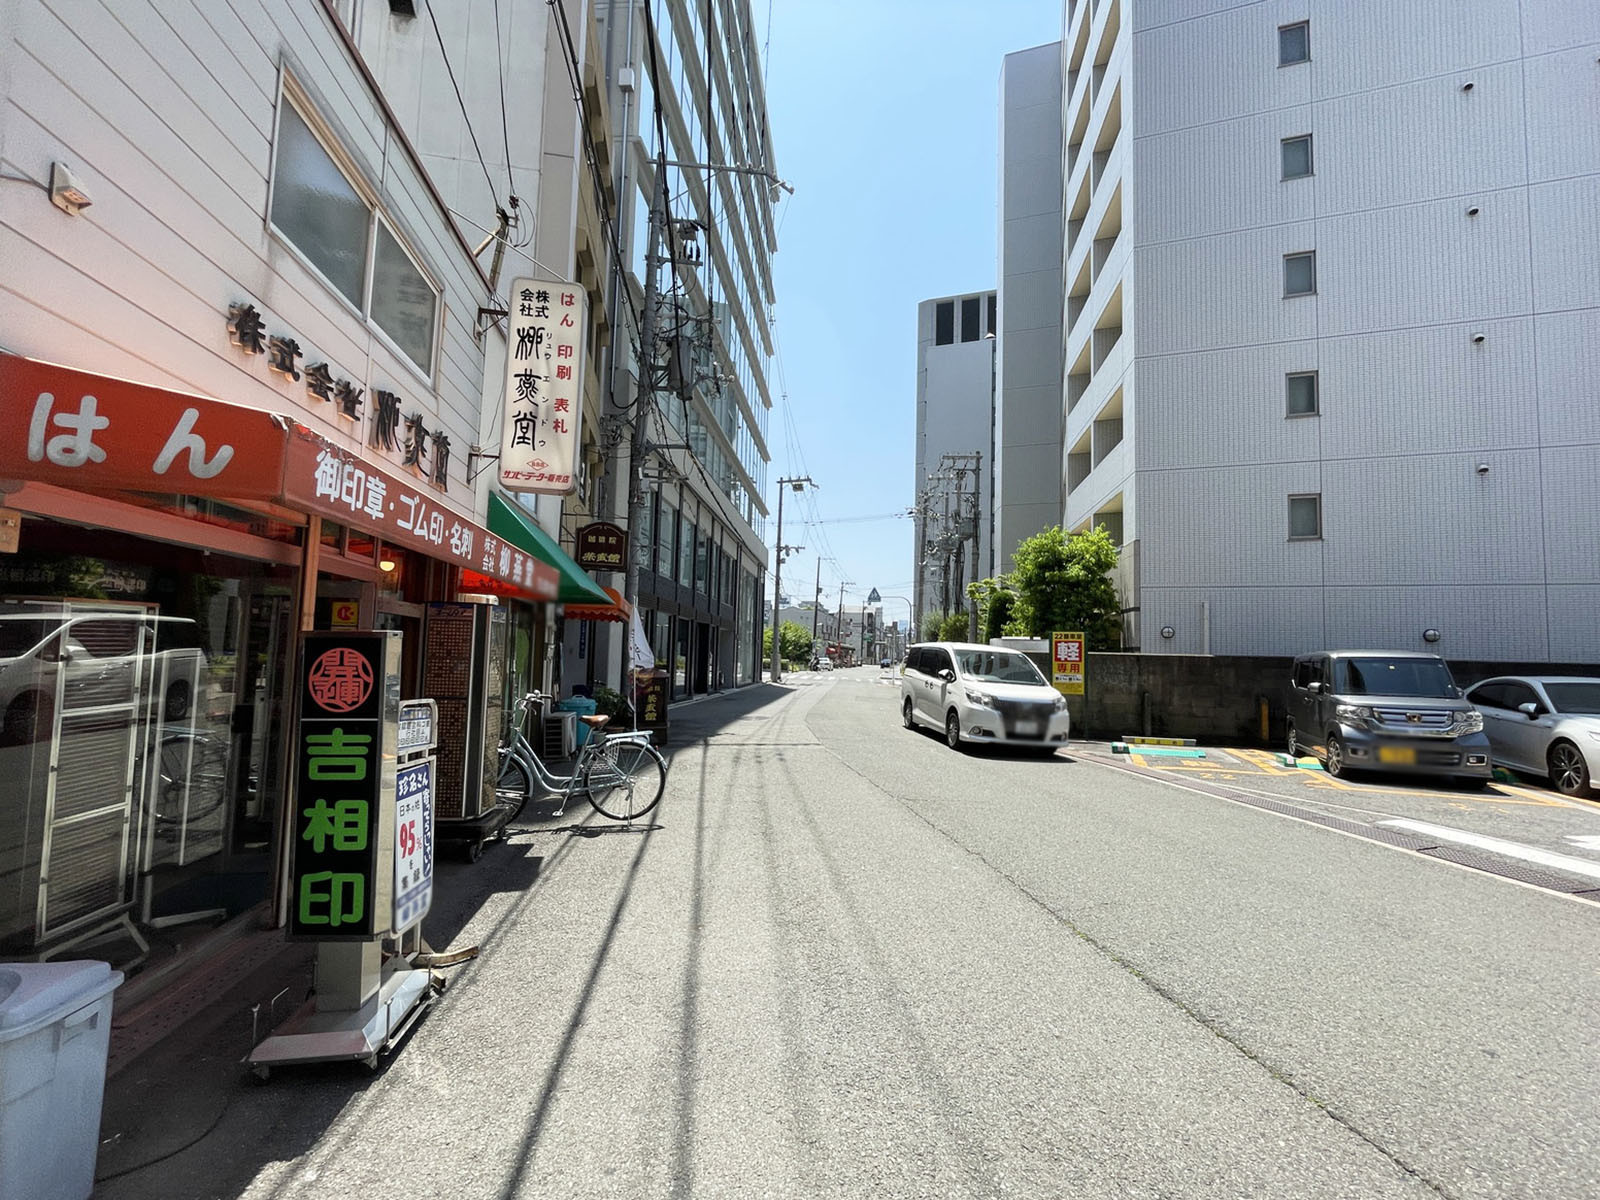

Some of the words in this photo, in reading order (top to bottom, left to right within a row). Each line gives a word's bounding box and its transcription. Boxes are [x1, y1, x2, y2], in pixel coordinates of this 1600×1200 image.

[559, 292, 575, 328] はん
[555, 344, 573, 380] 印刷
[552, 397, 569, 434] 表札
[27, 390, 235, 480] はん
[1057, 642, 1079, 661] 軽
[1057, 663, 1080, 673] 専用
[398, 770, 430, 797] 珍名さん
[299, 727, 373, 927] 吉相印
